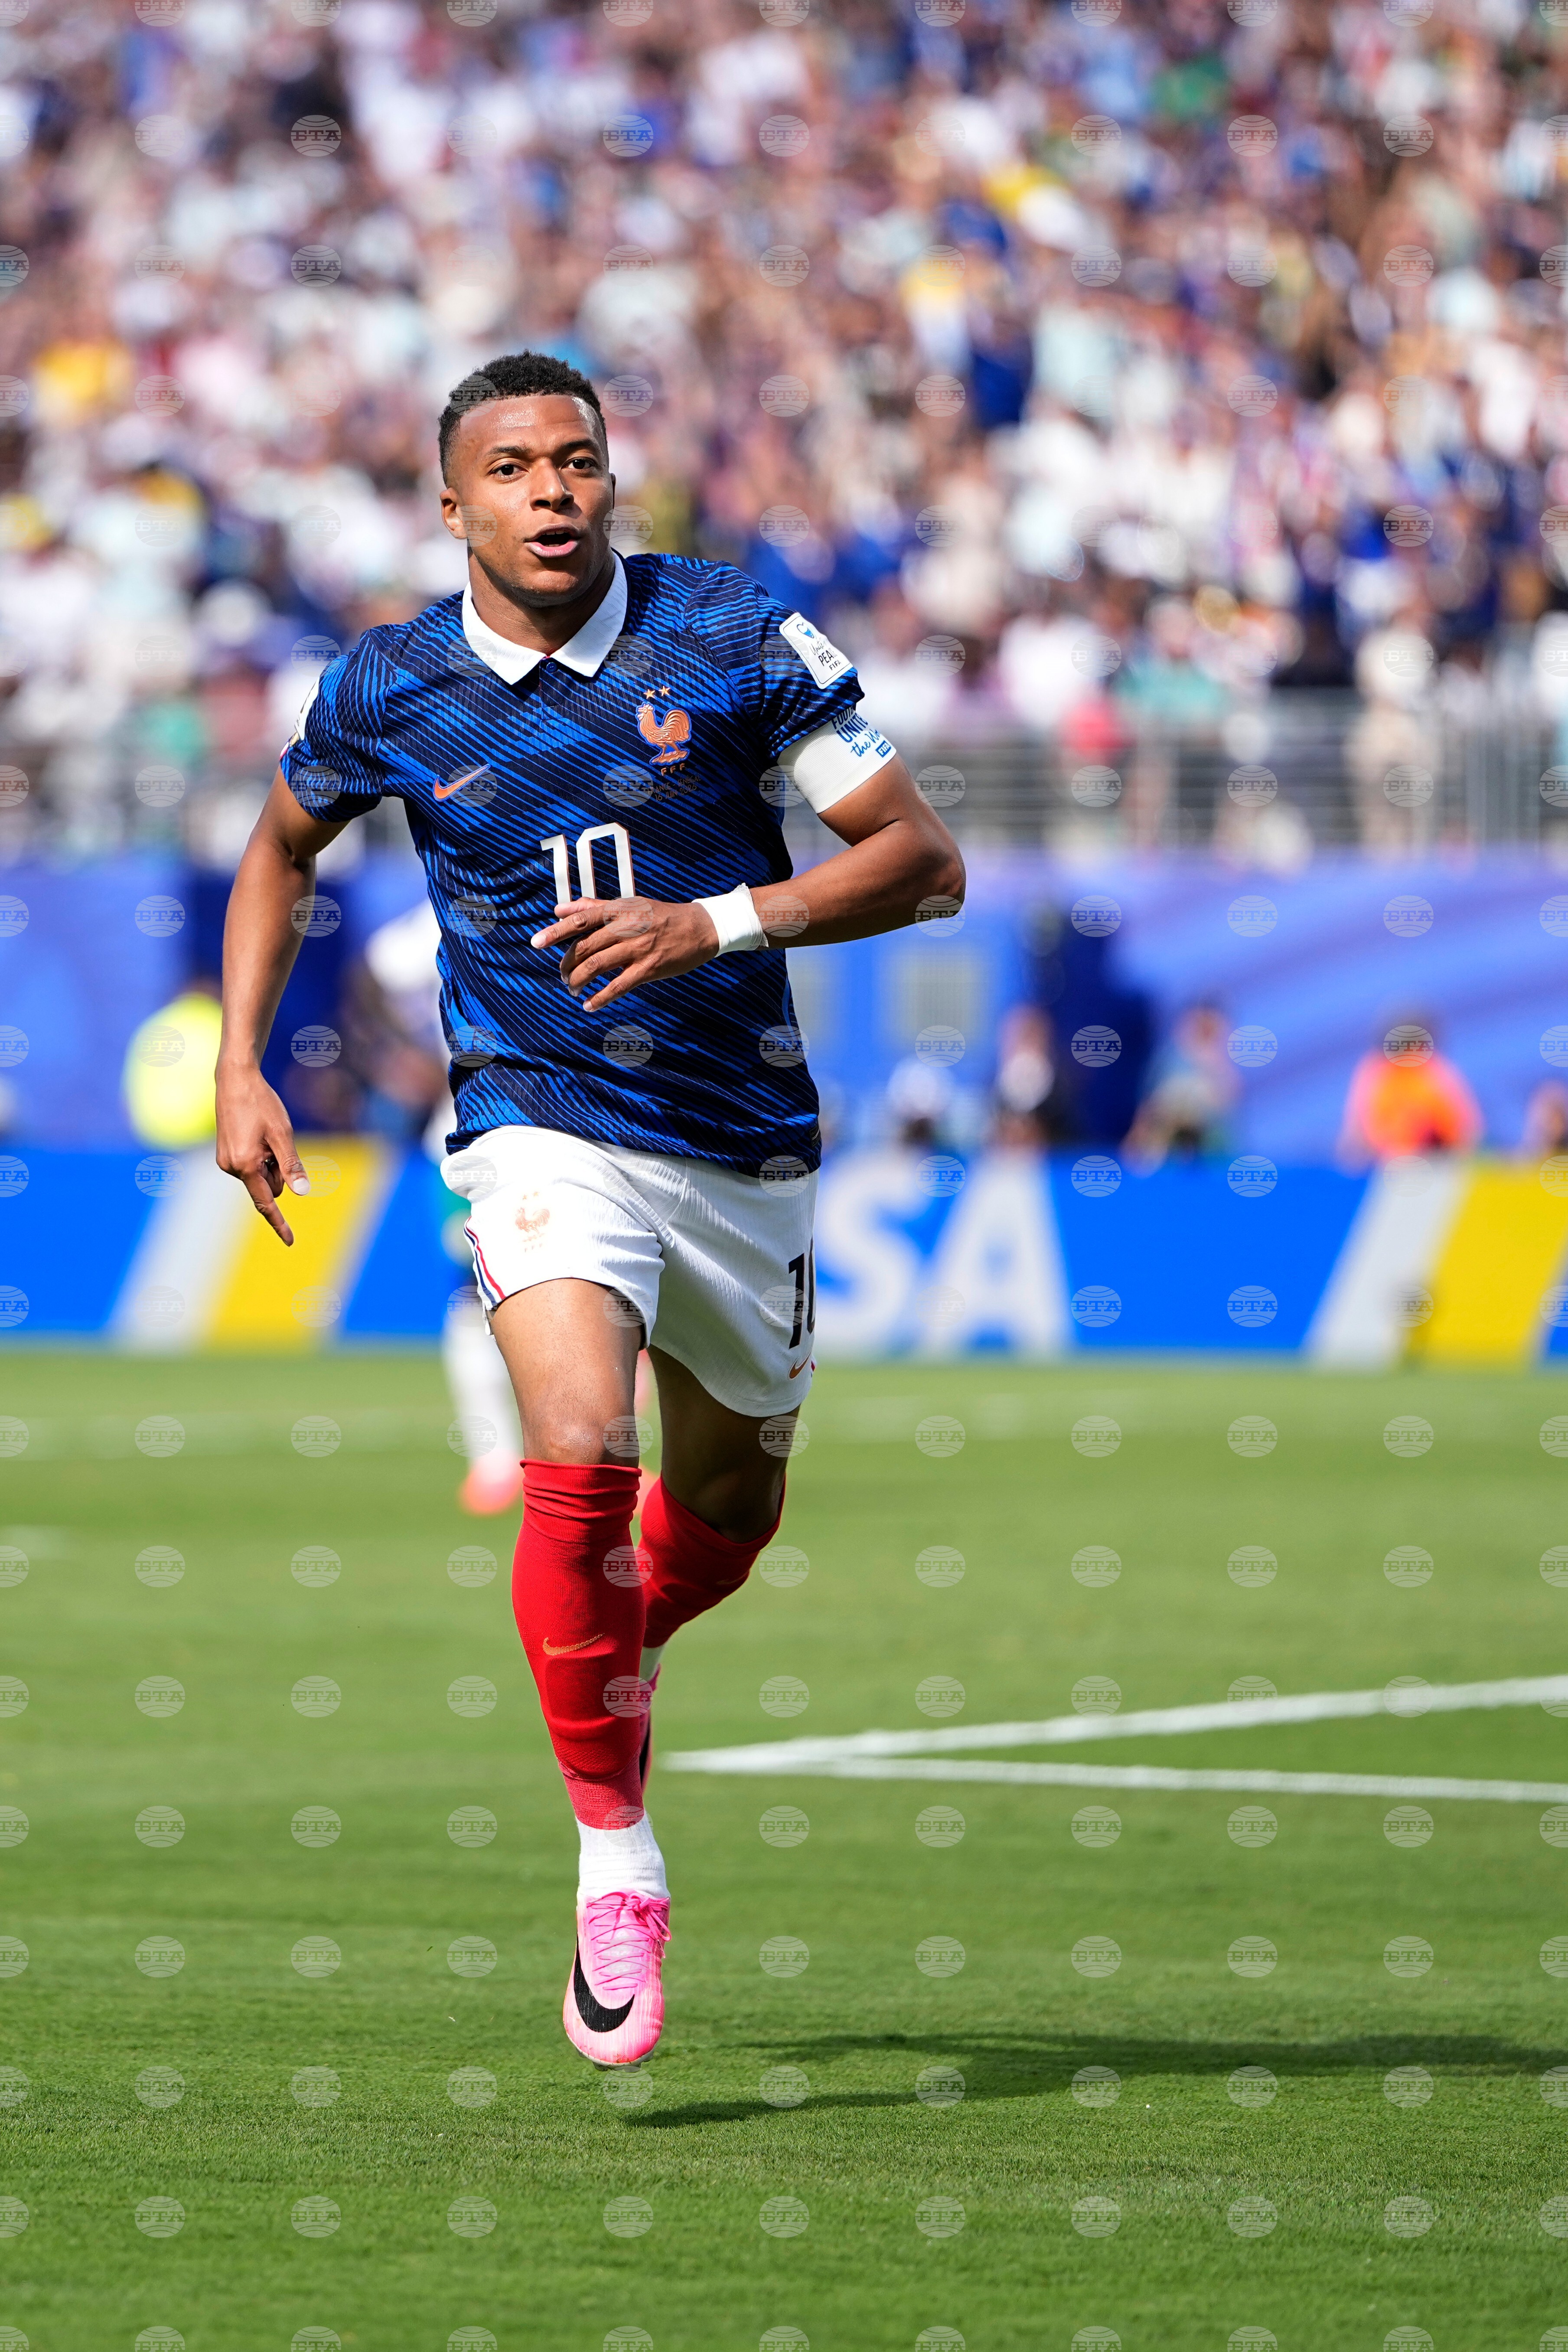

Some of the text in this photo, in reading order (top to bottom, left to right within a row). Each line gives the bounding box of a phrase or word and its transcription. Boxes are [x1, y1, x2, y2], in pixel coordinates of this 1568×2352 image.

[829, 660, 841, 670] FIFA
[836, 712, 868, 743] UNITE
[851, 741, 870, 757] the
[877, 742, 890, 755] FIFA
[665, 789, 678, 799] JUIN
[540, 822, 636, 922] 10
